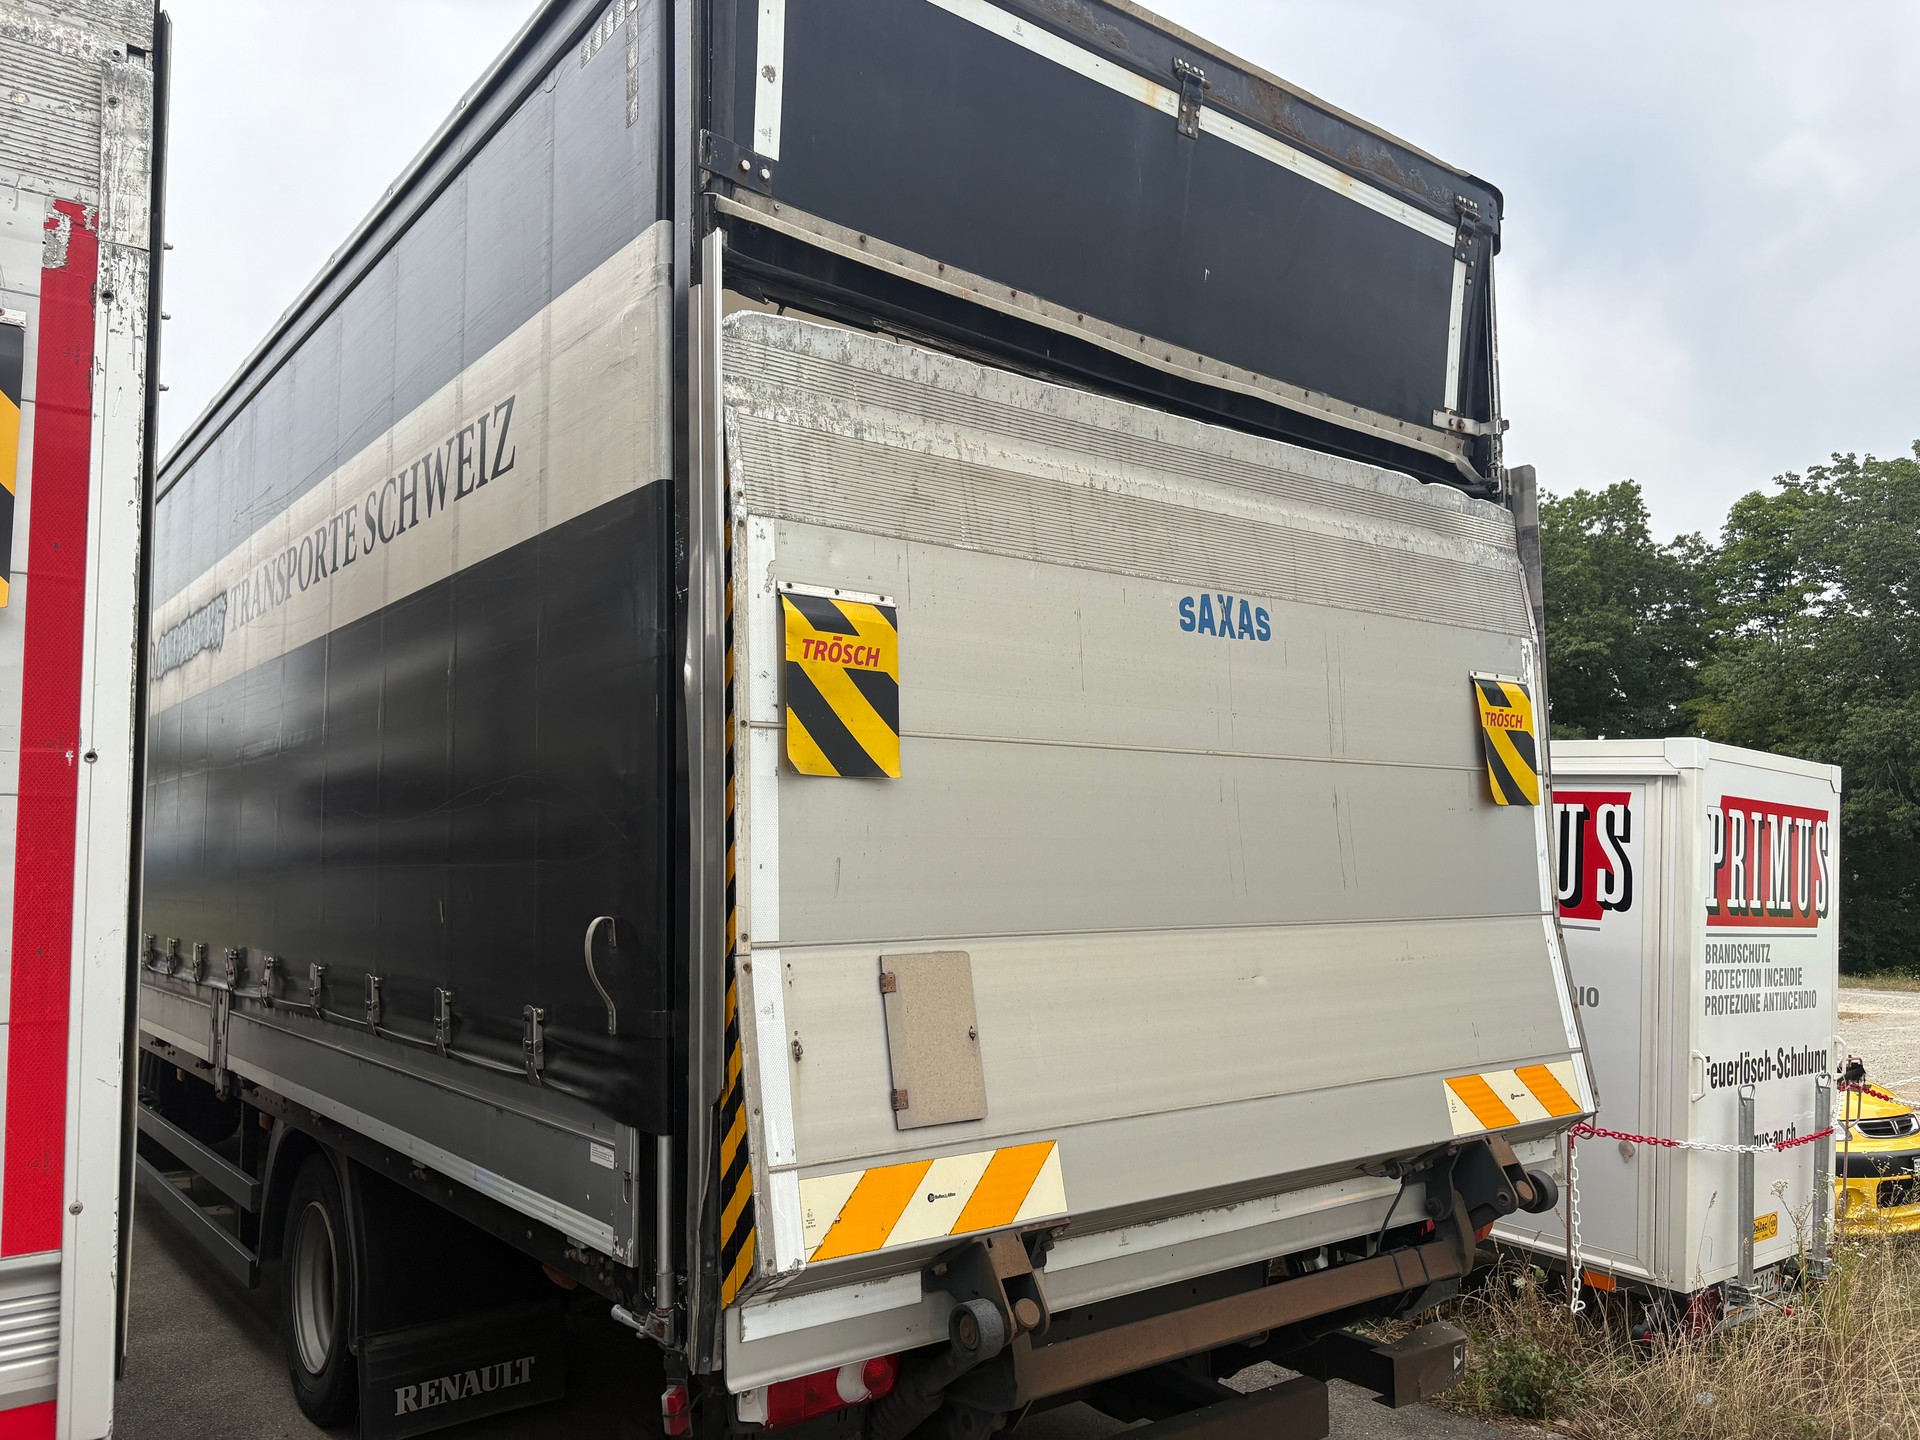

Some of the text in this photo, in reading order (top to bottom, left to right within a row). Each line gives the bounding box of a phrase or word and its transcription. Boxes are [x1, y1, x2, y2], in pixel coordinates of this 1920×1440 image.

[231, 394, 516, 632] TRANSPORTE SCHWEIZ
[1179, 593, 1271, 641] SAXAS
[1705, 805, 1829, 919] PRIMUS
[1705, 943, 1771, 964] BRANDSCHUTZ
[1574, 986, 1599, 1007] IO
[1705, 967, 1802, 990] PROTECTION INCENDIE
[1704, 989, 1817, 1016] PROTEZIONE ANTINCENDIO
[394, 1356, 535, 1416] RENAULT
